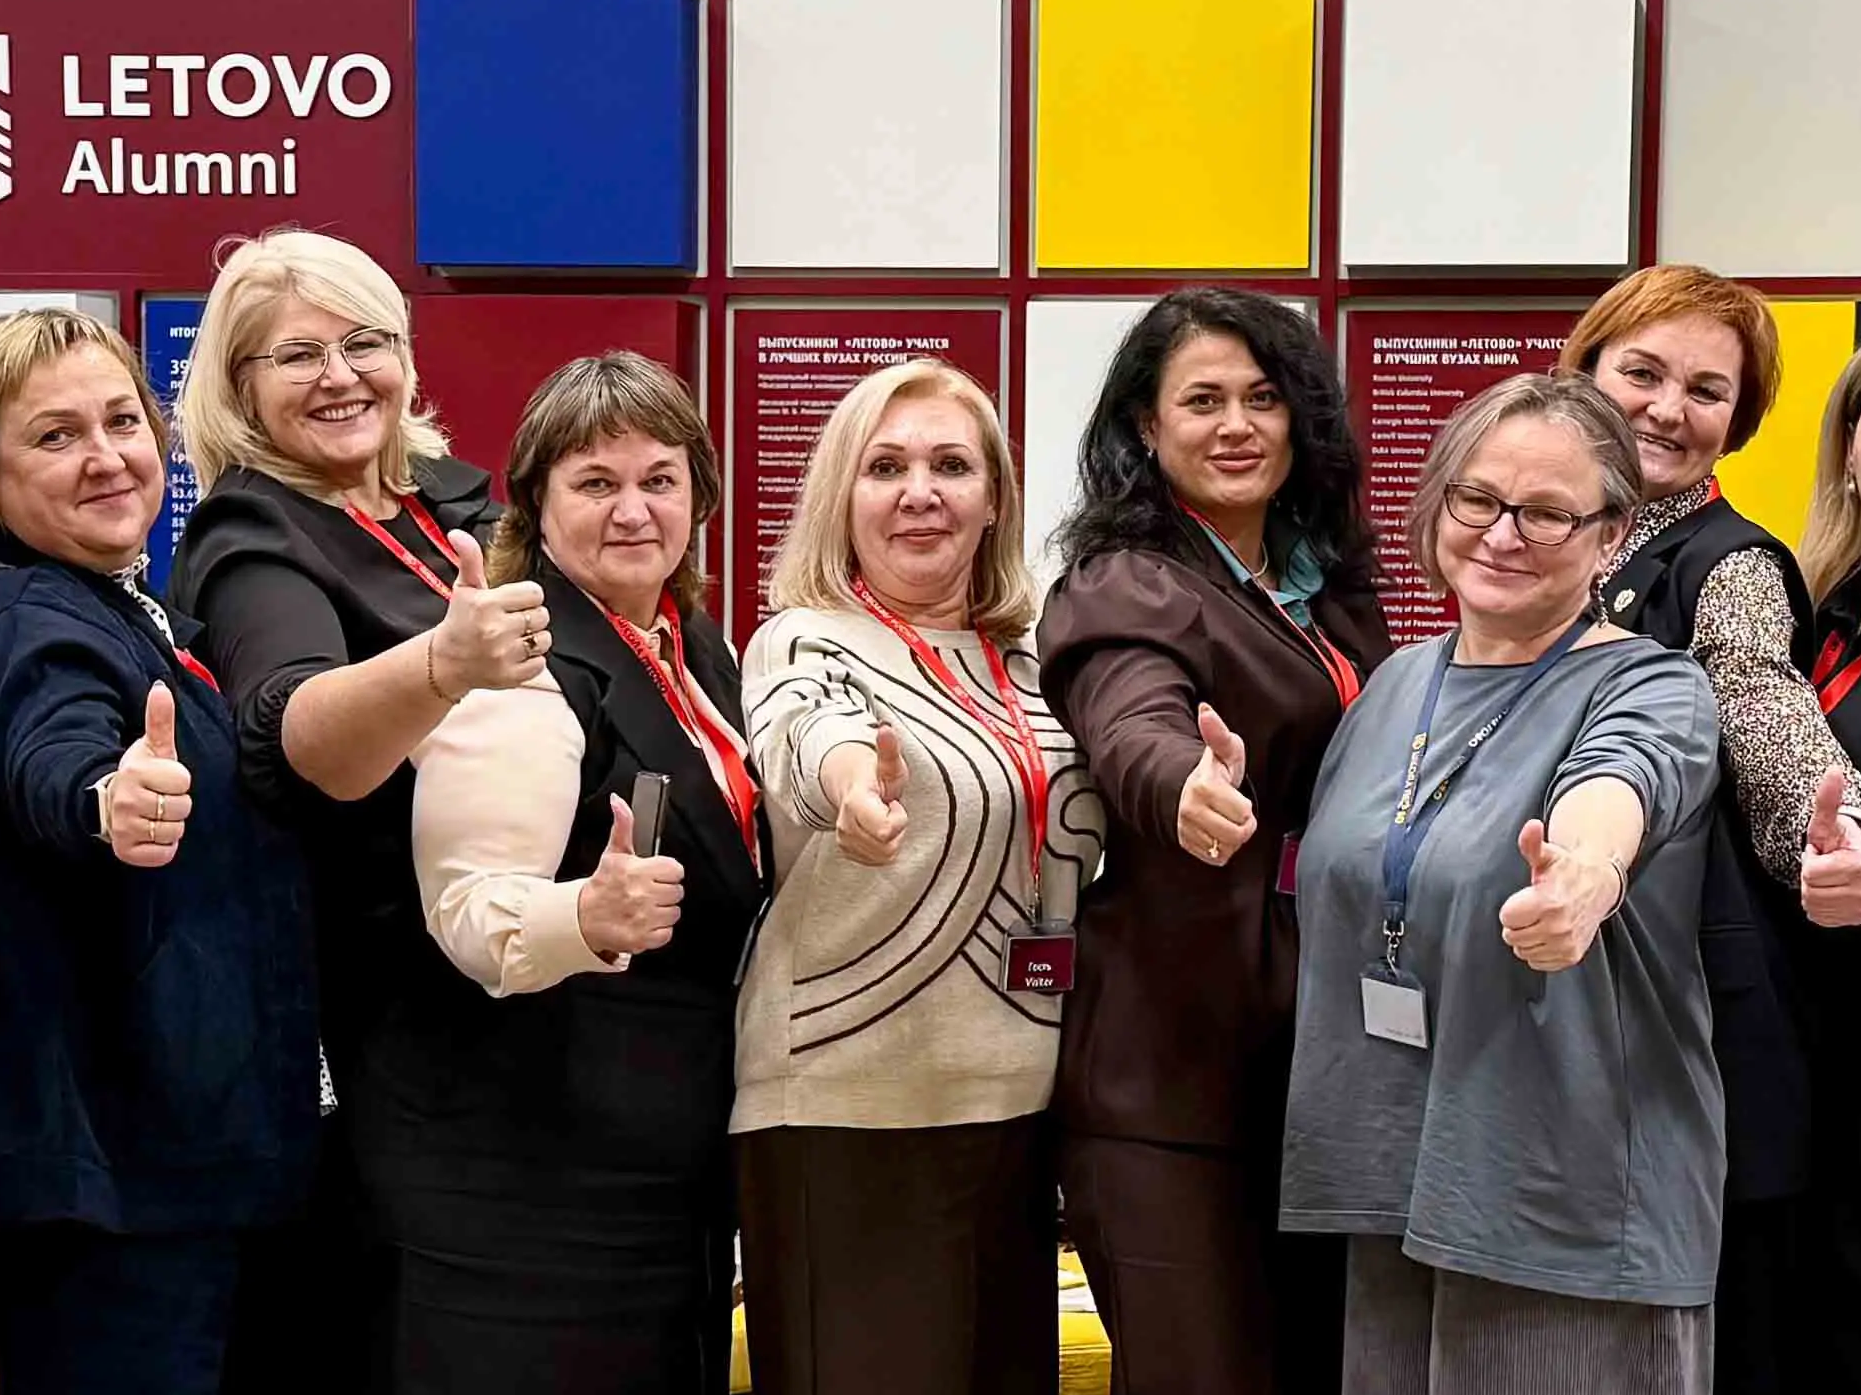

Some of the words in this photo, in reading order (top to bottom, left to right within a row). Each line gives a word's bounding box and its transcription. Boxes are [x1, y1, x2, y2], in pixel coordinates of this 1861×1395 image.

[63, 53, 392, 118] LETOVO
[61, 138, 297, 196] Alumni
[758, 337, 839, 349] ВЫПУСКНИКИ
[844, 337, 903, 350] «ЛЕТОВО»
[905, 337, 950, 349] УЧАТСЯ
[1373, 337, 1458, 350] ВЫПУСКНИКИ
[1460, 337, 1522, 350] «ЛЕТОВО»
[1525, 337, 1569, 351] УЧАТС
[758, 352, 767, 364] В
[770, 352, 821, 365] ЛУЧШИХ
[823, 352, 861, 364] ВУЗАХ
[1373, 352, 1382, 365] В
[1384, 352, 1438, 365] ЛУЧШИХ
[1441, 352, 1481, 365] ВУЗАХ
[1483, 352, 1520, 365] МИРА
